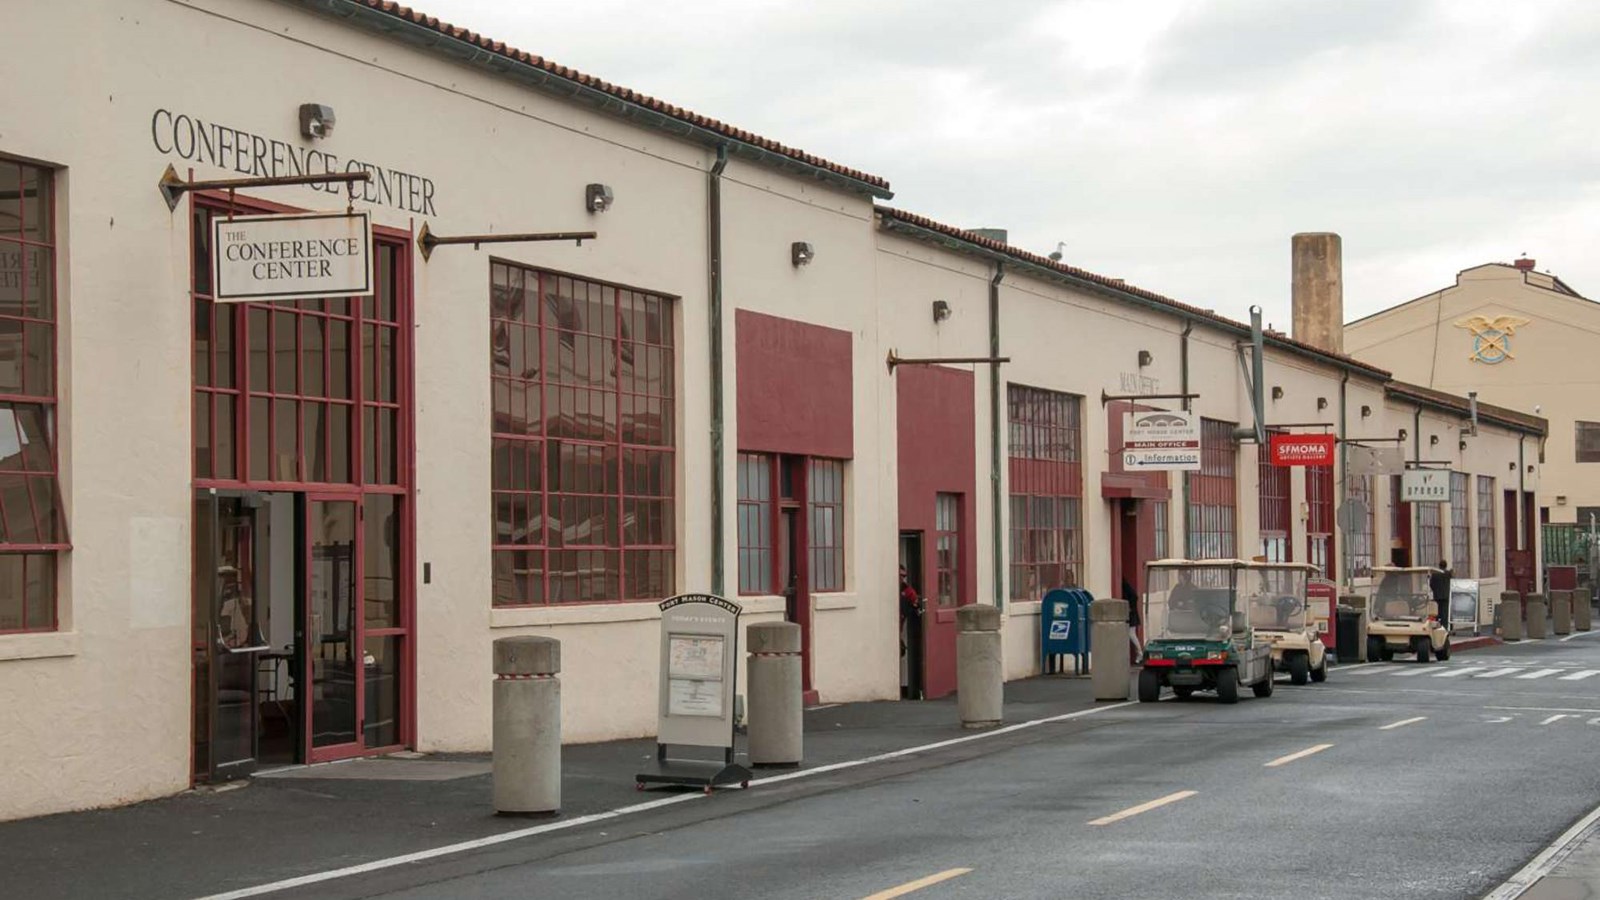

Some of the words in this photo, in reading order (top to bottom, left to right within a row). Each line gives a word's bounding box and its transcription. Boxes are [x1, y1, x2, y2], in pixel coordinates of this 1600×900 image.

[151, 108, 338, 195] CONFERENCE
[345, 159, 438, 217] CENTER
[225, 231, 247, 242] THE
[226, 238, 359, 262] CONFERENCE
[252, 259, 332, 280] CENTER
[1144, 453, 1197, 462] Information
[1279, 445, 1326, 454] SFMOMA
[661, 598, 679, 610] FORT
[709, 597, 737, 614] CENTER
